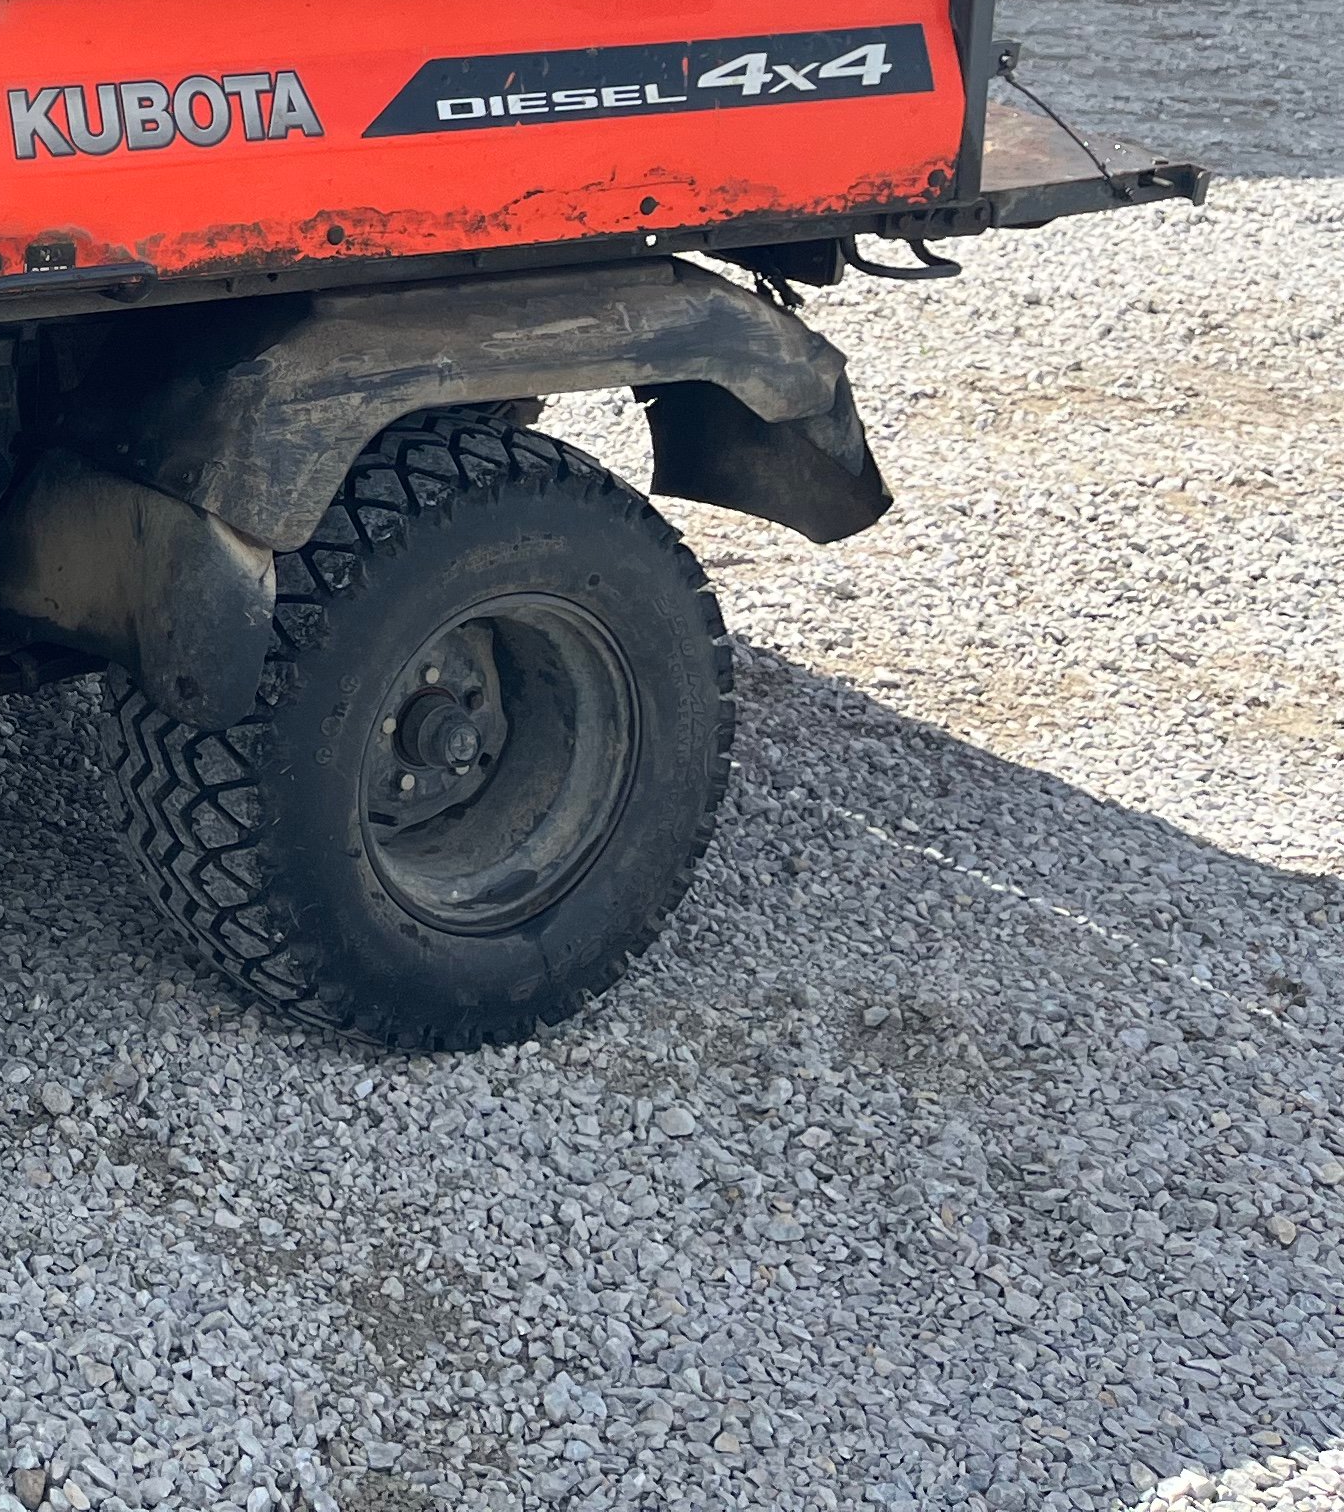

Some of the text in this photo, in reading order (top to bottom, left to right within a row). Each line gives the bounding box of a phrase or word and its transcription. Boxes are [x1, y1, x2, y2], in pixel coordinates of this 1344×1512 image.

[7, 68, 325, 161] KUBOTA
[435, 43, 894, 122] DIESEL 4x4
